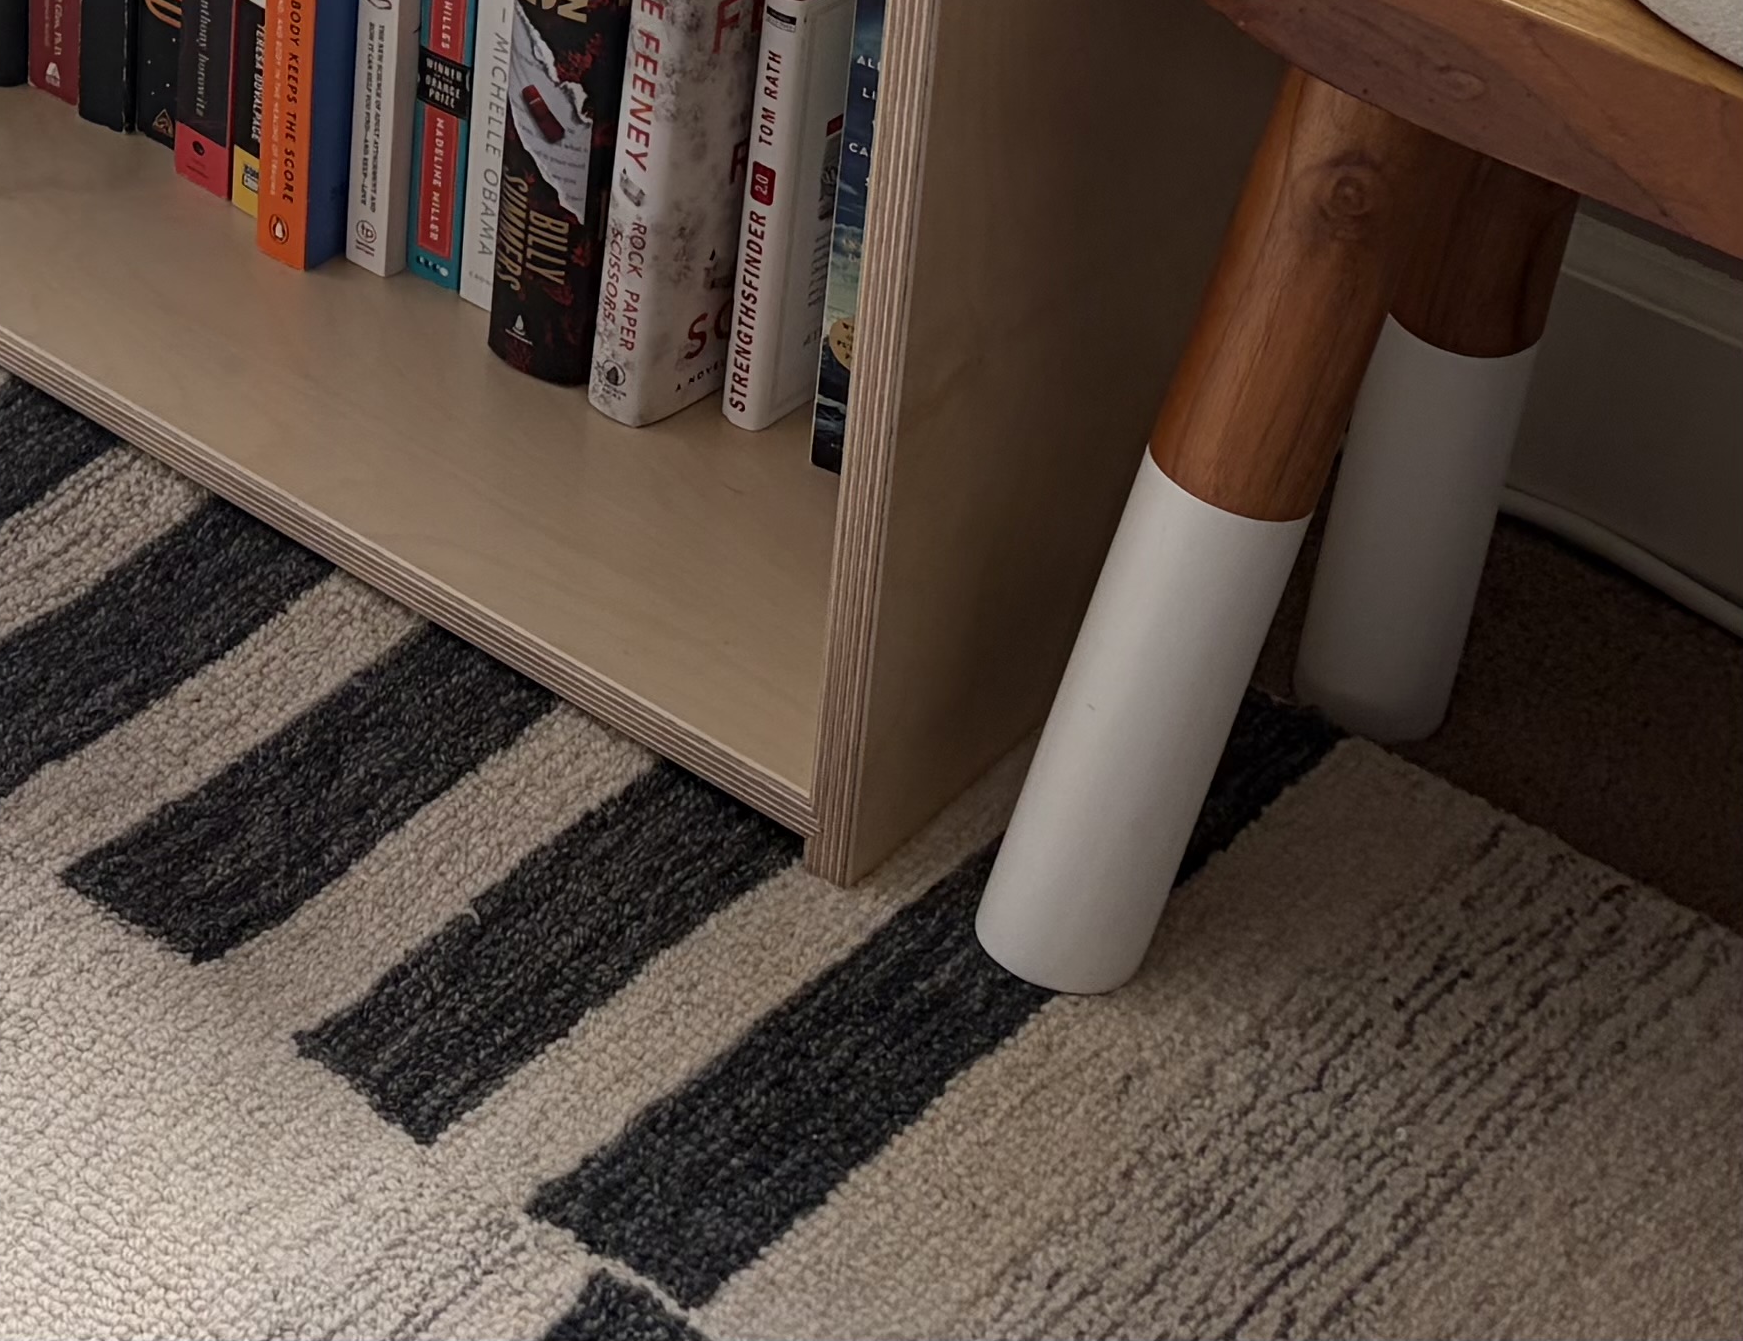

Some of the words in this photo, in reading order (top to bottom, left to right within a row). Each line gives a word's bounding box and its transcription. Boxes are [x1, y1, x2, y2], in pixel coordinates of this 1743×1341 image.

[288, 2, 303, 47] BODY
[194, 51, 210, 118] horowitz
[285, 51, 300, 105] KEEPS
[425, 57, 464, 82] WINNER
[425, 72, 461, 100] ORANGE
[428, 87, 457, 110] PRIZE
[484, 32, 510, 157] MICHELLE
[764, 50, 783, 100] RATH
[284, 108, 297, 144] THE
[618, 29, 662, 172] FEENEY
[758, 106, 777, 147] TOM
[282, 147, 296, 204] SCORE
[432, 117, 445, 187] MADELINE
[428, 187, 441, 242] MILLER
[478, 168, 499, 256] OBAMA
[496, 173, 529, 292] SUMMERS
[525, 209, 570, 285] BILLY
[627, 221, 648, 279] ROCK
[601, 226, 624, 329] SCISSORS
[729, 210, 767, 413] STRENGTHSFINDER
[753, 173, 770, 196] 2.0
[618, 288, 641, 353] PAPER
